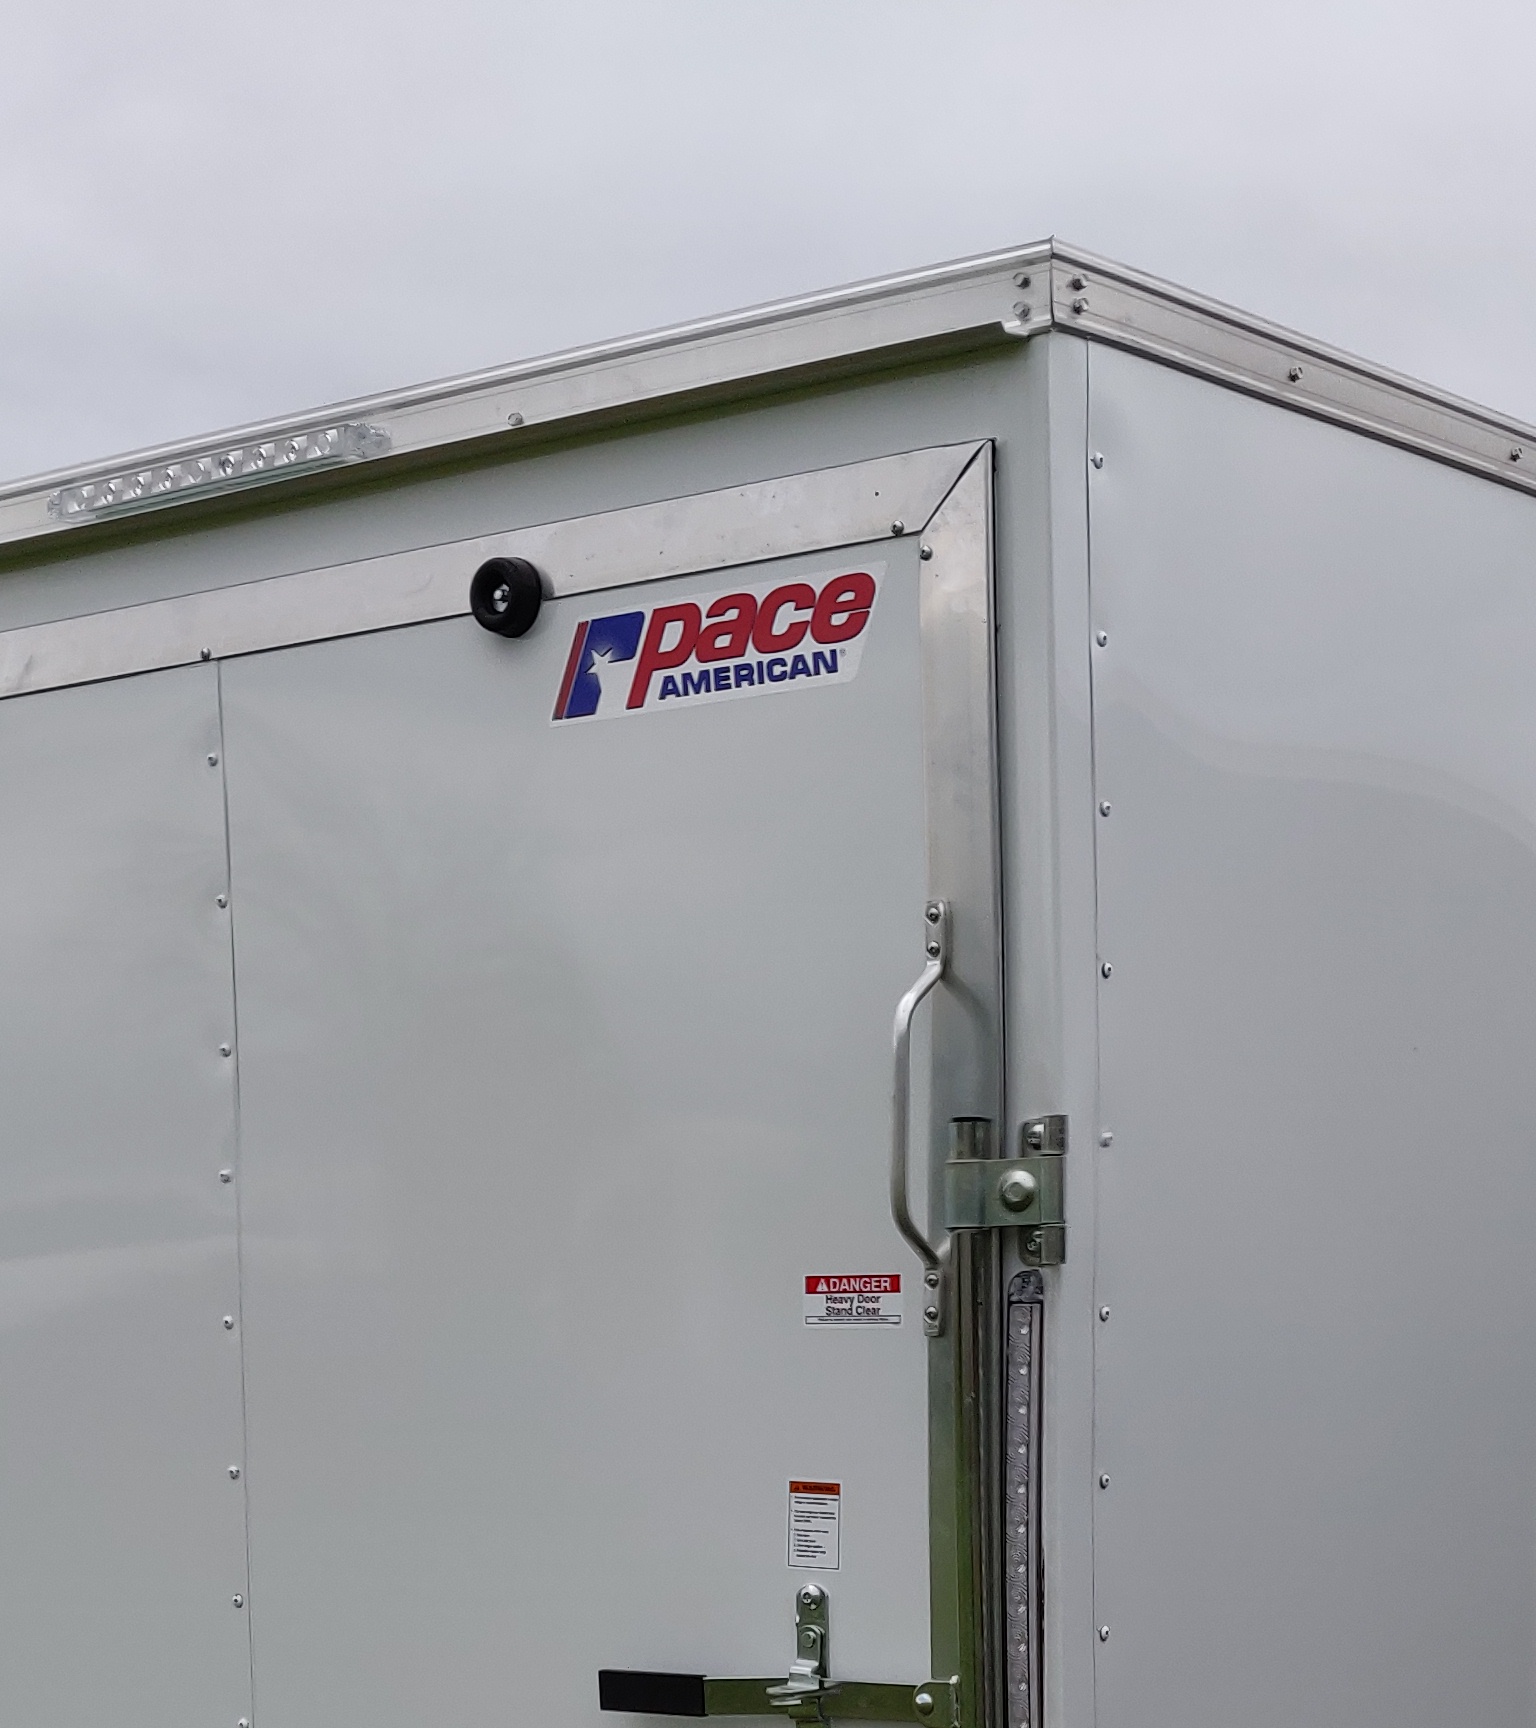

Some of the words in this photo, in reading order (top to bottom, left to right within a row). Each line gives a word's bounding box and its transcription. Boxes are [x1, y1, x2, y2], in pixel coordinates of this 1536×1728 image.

[626, 572, 876, 710] pace
[658, 649, 839, 700] AMERICAN
[829, 1277, 891, 1292] DANGER
[825, 1295, 855, 1307] Heavy
[857, 1294, 881, 1304] Door
[825, 1305, 853, 1316] Stand
[855, 1305, 881, 1316] Clear
